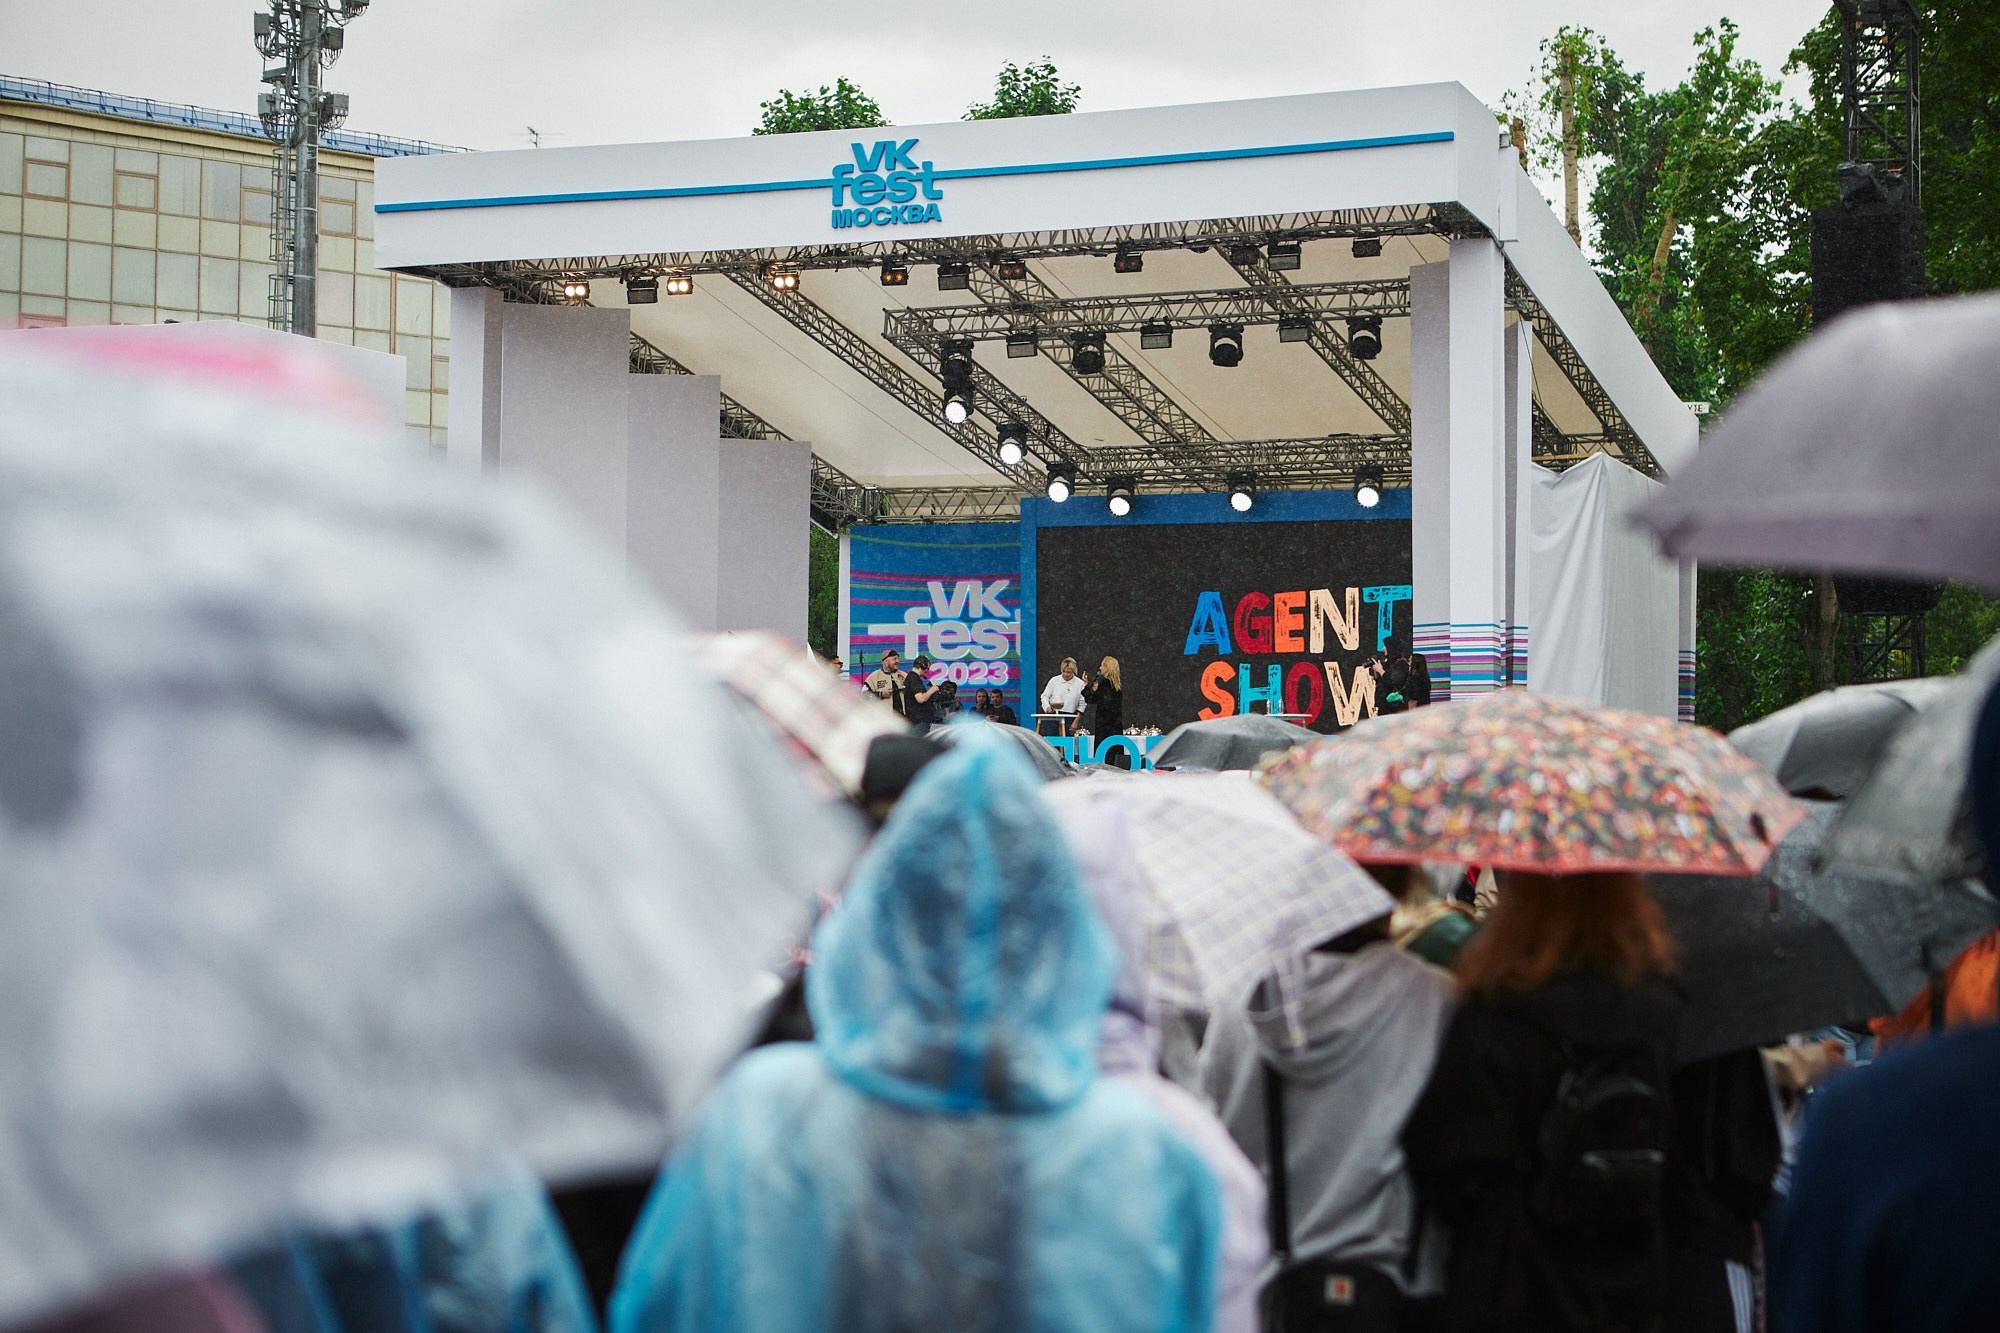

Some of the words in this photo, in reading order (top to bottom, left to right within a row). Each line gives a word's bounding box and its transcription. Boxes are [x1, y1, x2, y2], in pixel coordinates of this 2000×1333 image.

[851, 138, 919, 173] VK
[832, 161, 943, 206] fest
[832, 203, 942, 228] МОСКВА
[926, 579, 1011, 618] VK
[903, 606, 1021, 661] fes
[1183, 585, 1413, 656] AGENT
[930, 661, 1009, 685] 2023
[1197, 660, 1379, 727] SHOW
